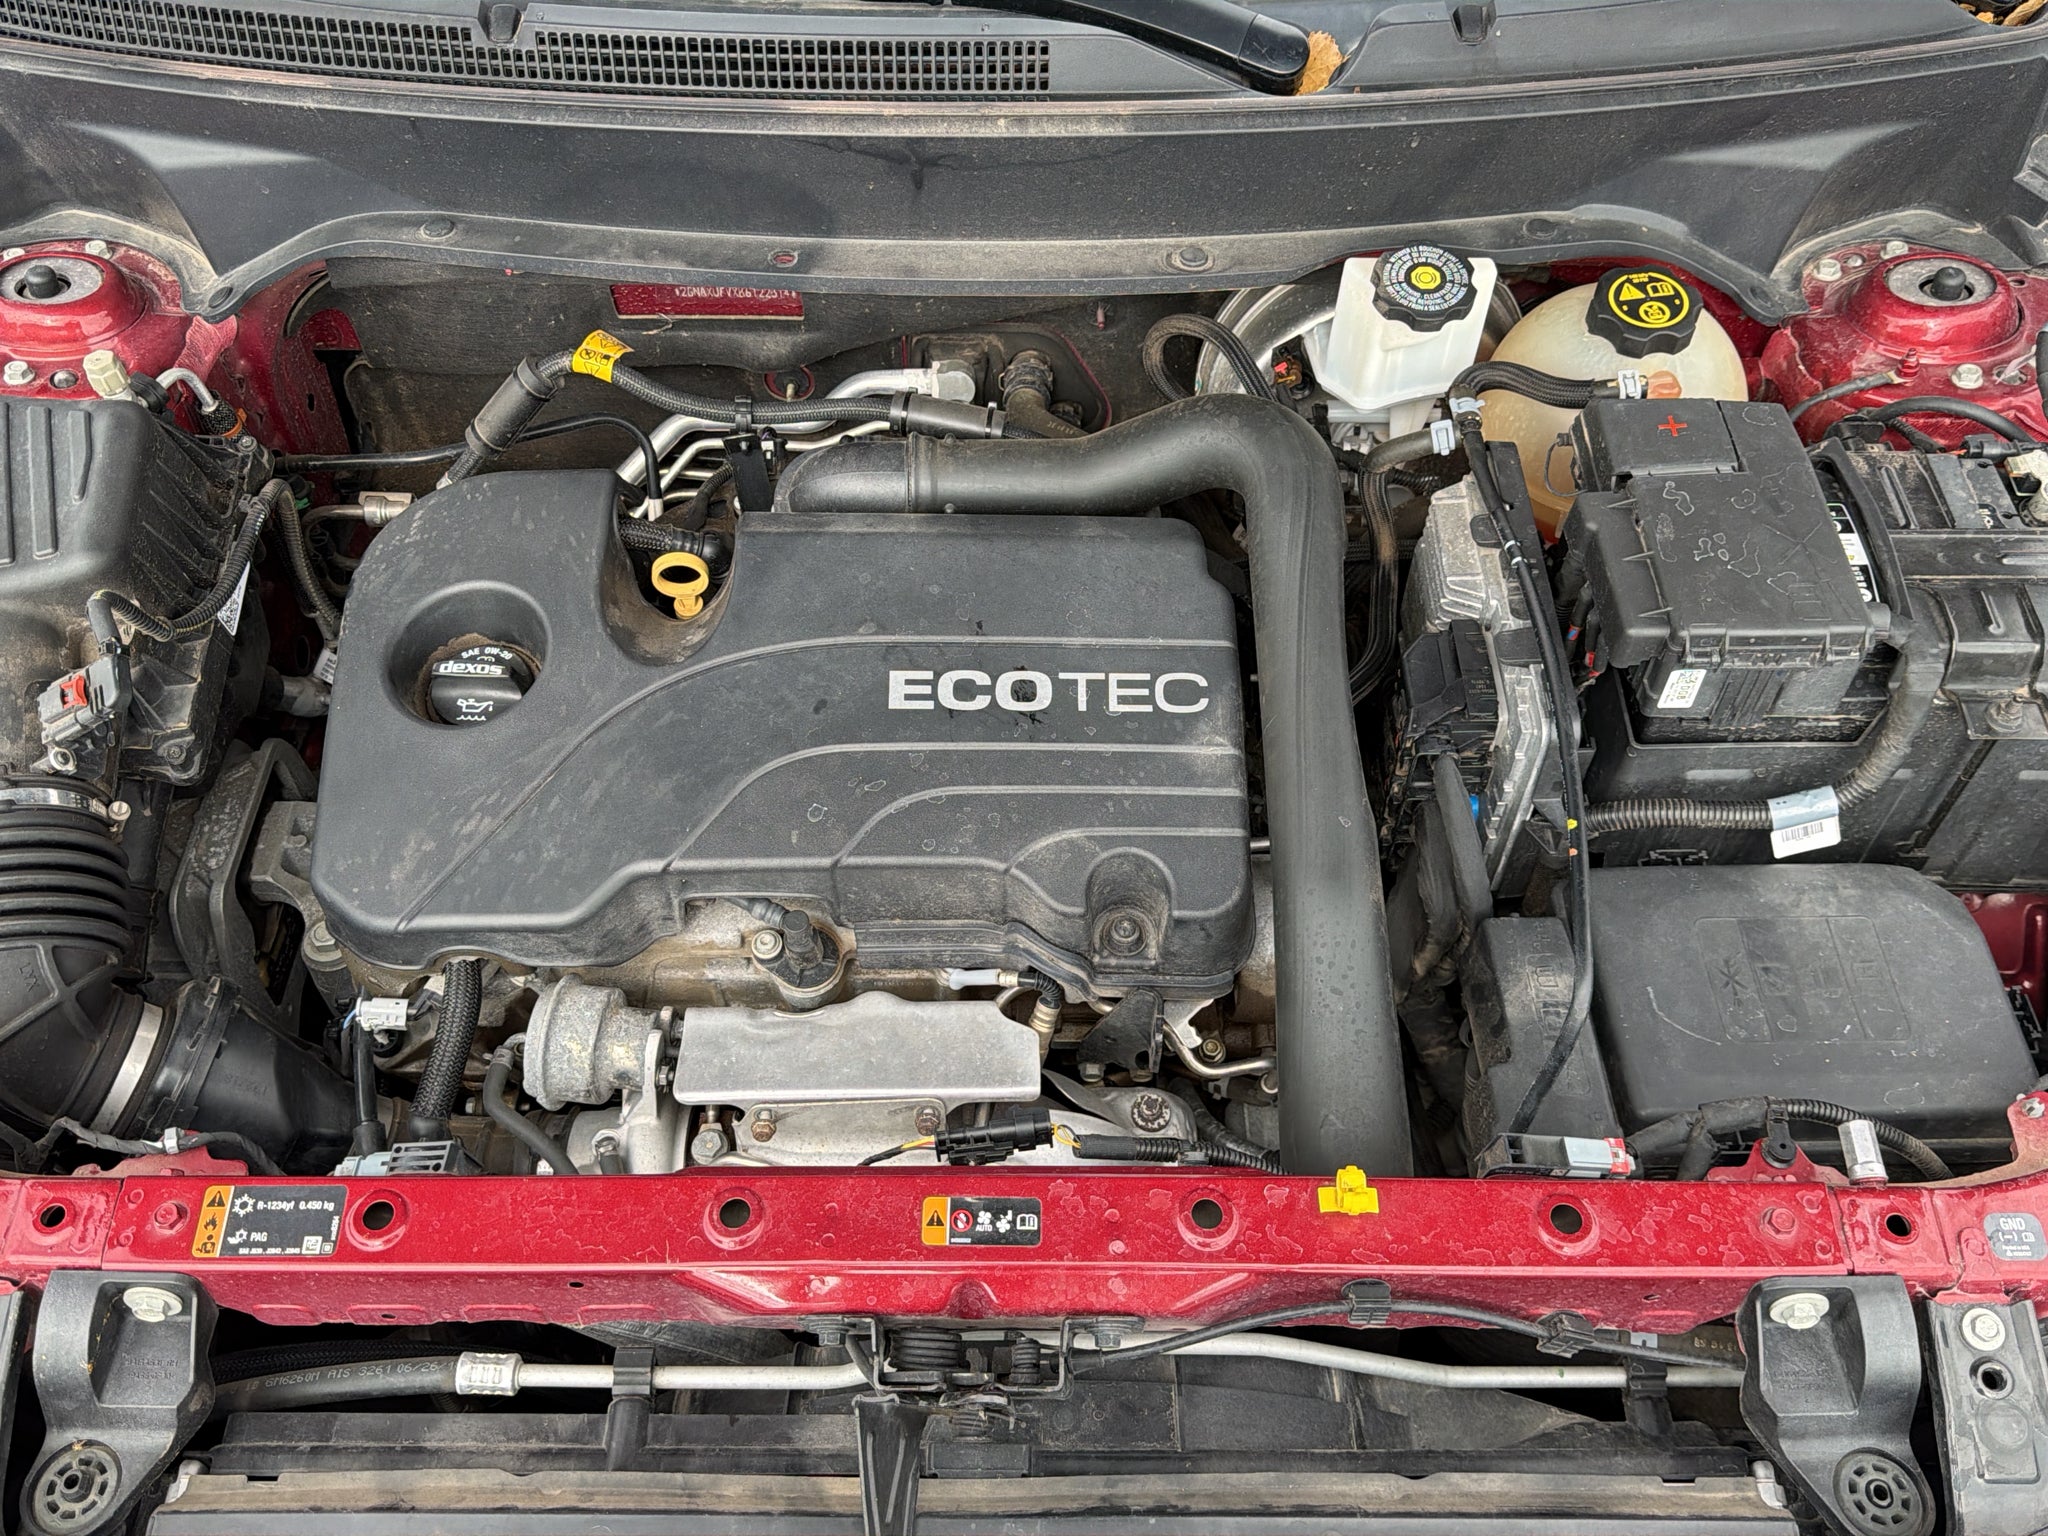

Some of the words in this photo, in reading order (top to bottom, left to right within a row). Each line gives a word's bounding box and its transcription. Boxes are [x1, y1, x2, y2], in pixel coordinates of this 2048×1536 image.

[461, 647, 481, 659] SAE
[484, 647, 513, 660] 0W-20
[439, 660, 506, 675] dexos
[888, 669, 1209, 713] ECOTEC
[256, 1200, 295, 1212] R-1234yf
[299, 1200, 322, 1210] 0.450
[323, 1200, 335, 1212] kg
[975, 1224, 993, 1232] AUTO
[1999, 1217, 2026, 1230] GND
[250, 1231, 268, 1242] PAG
[327, 1367, 352, 1379] AIS
[397, 1360, 458, 1374] 06/26/1
